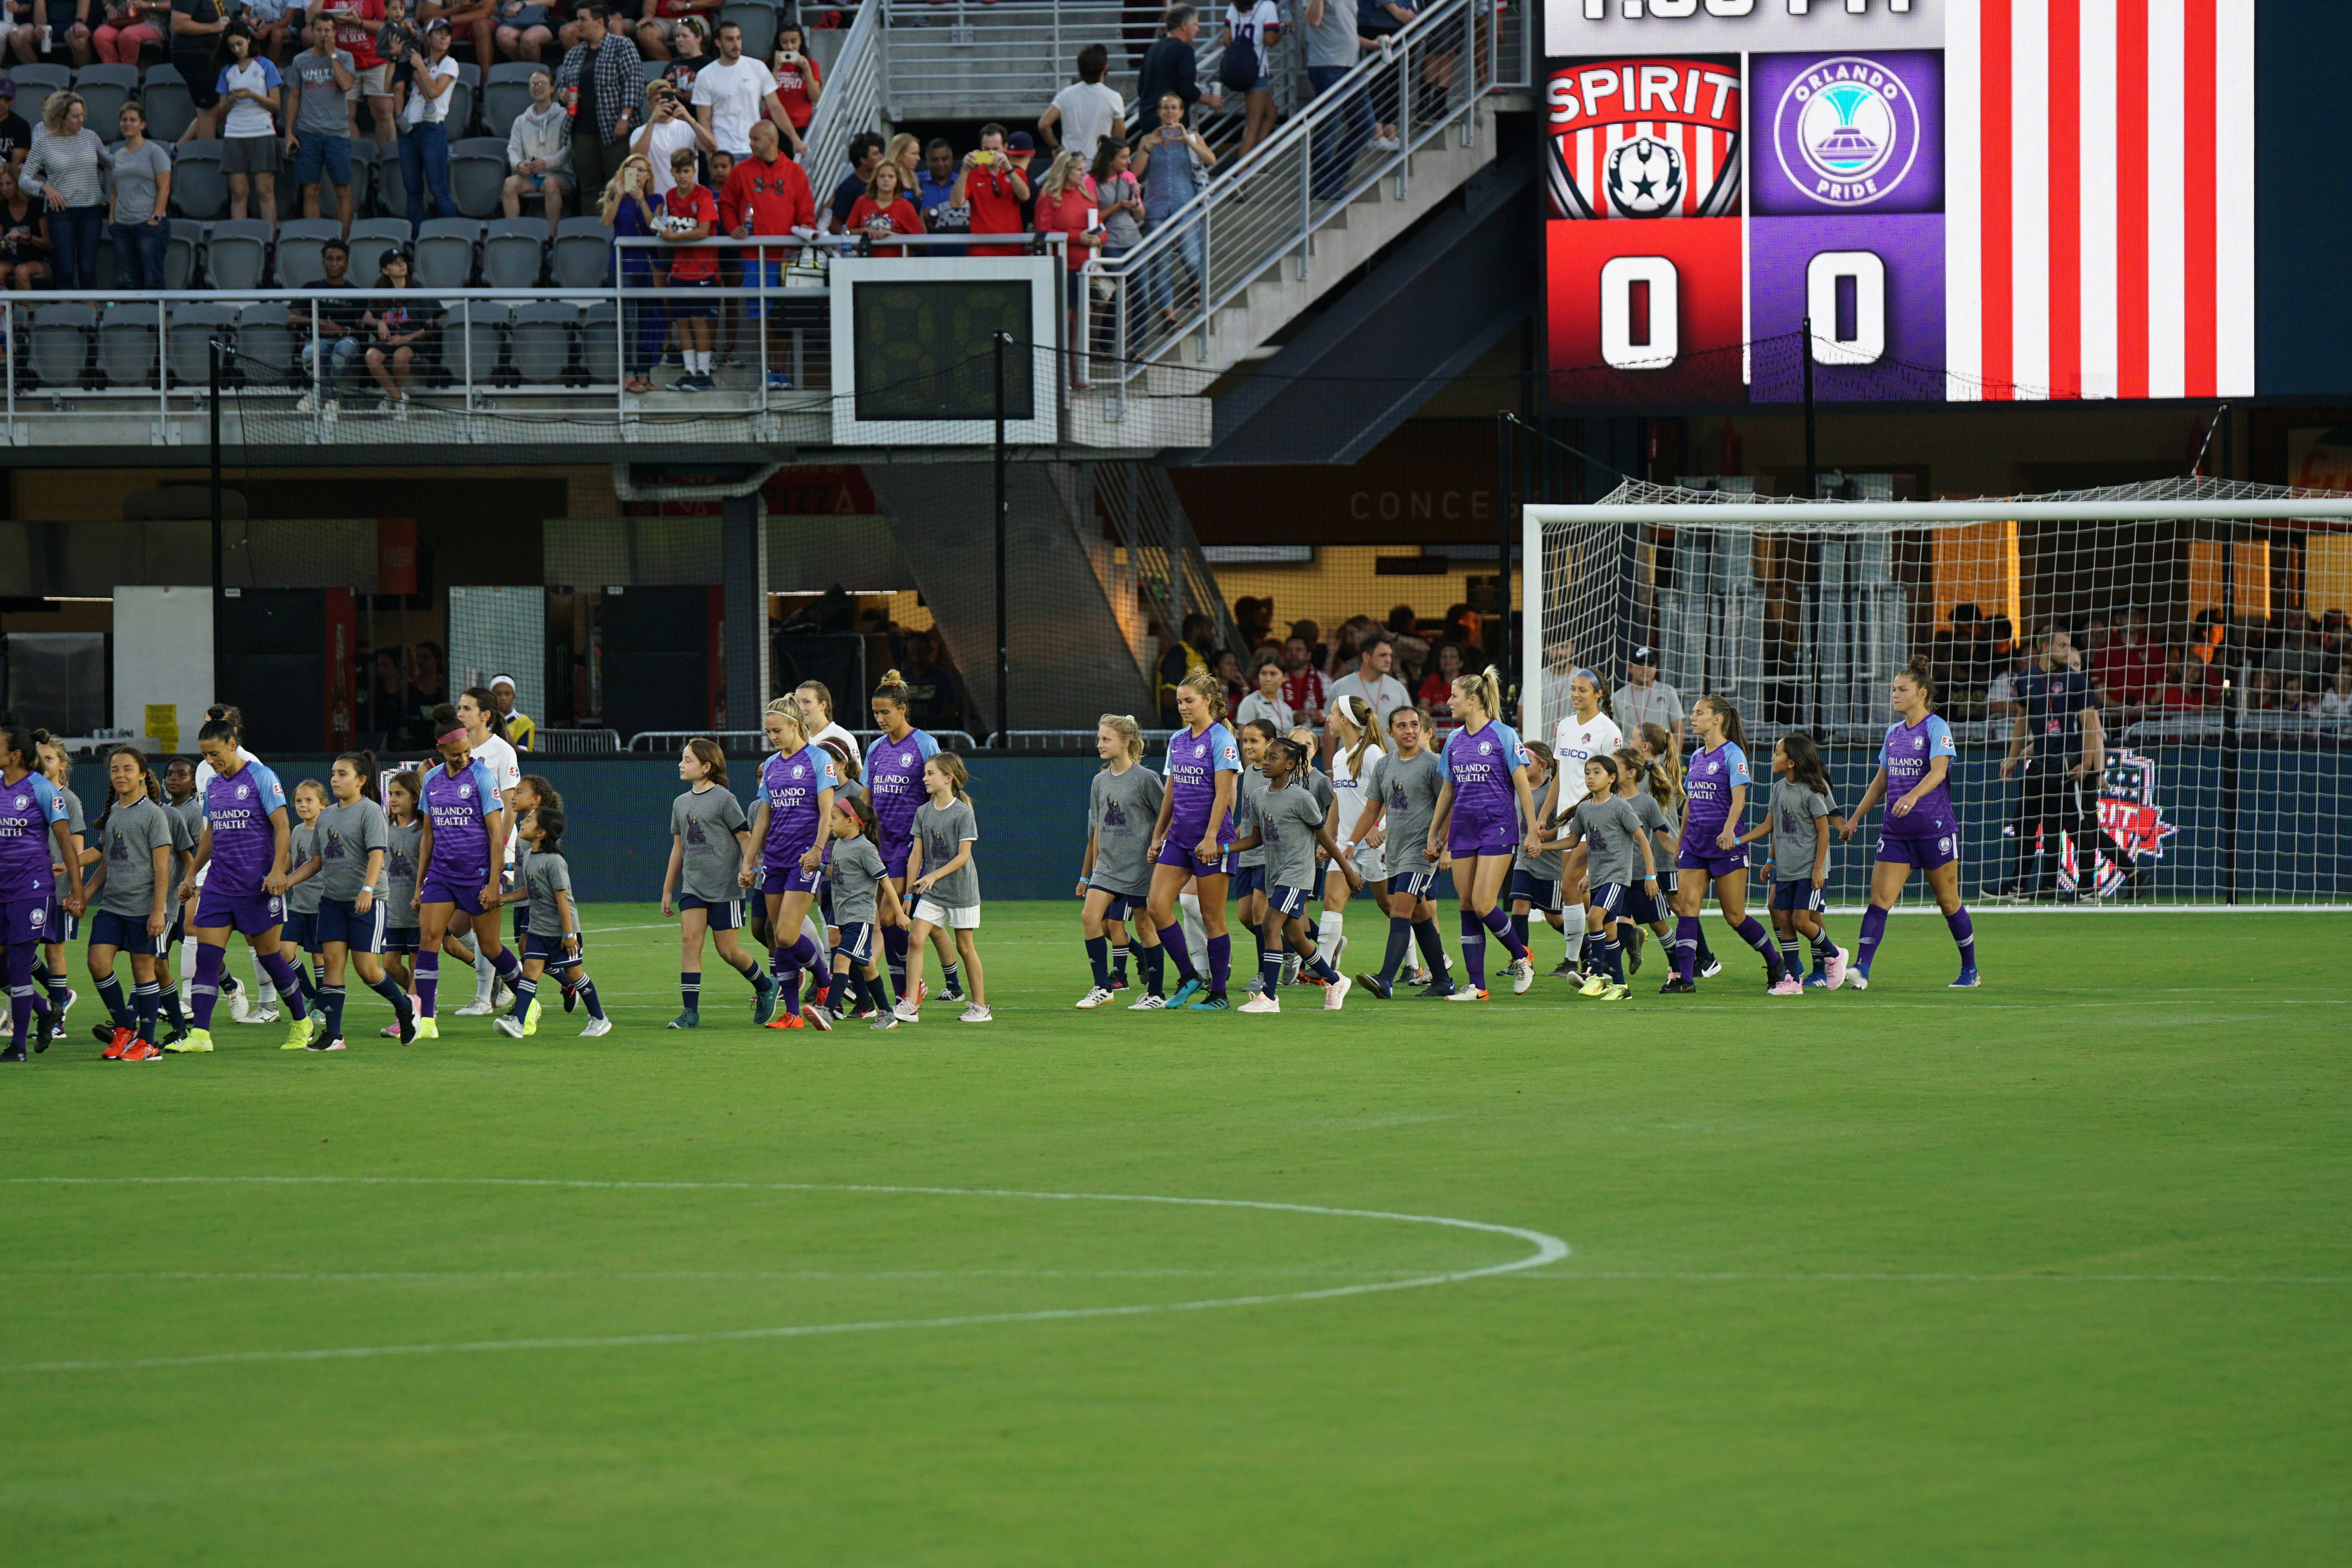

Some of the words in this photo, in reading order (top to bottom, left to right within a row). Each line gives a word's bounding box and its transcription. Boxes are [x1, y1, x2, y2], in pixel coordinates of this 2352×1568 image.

[1795, 65, 1899, 102] ORLANDO
[1548, 65, 1740, 124] SPIRIT
[1817, 177, 1877, 199] PRIDE
[1601, 257, 1678, 369] 0
[1808, 251, 1885, 365] 0
[1888, 757, 1923, 766] ORLANDO
[1173, 764, 1203, 775] RLANDO
[1889, 766, 1919, 776] HEALTH
[1173, 774, 1200, 784] HEALTH
[1688, 781, 1717, 790] RLANDO
[210, 809, 250, 820] ORLANDO
[430, 806, 473, 816] ORLANDO
[213, 820, 246, 830] HEALTH
[434, 816, 468, 826] HEALTH
